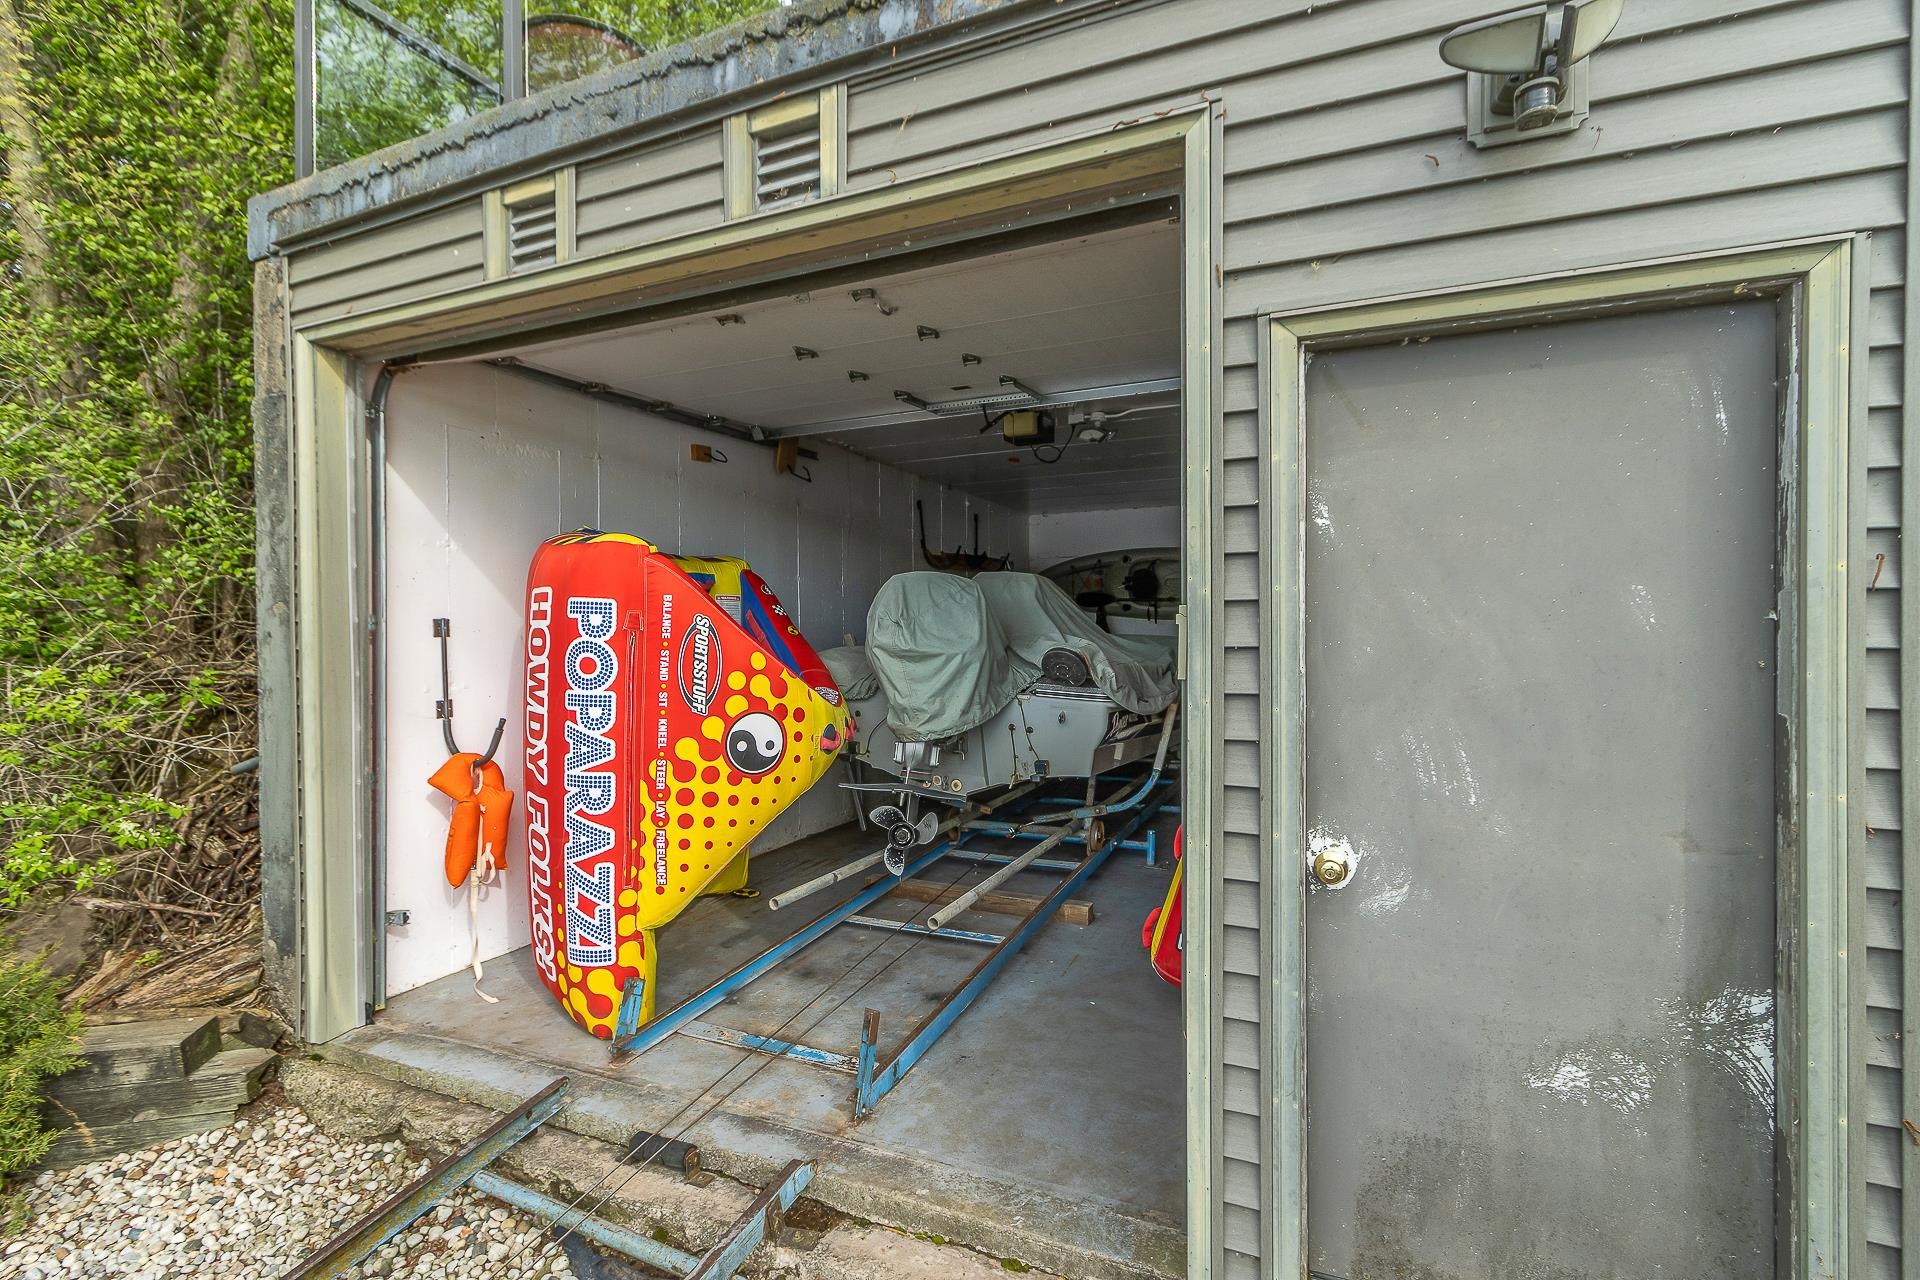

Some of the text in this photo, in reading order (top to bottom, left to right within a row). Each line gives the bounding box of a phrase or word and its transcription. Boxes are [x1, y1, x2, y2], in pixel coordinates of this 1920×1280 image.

[526, 586, 557, 982] HOWDY FOLKS!
[564, 596, 618, 966] POPARAZZI
[655, 594, 673, 886] BALANCE STAND SIT KNEEL STEER LAY FREELANCE
[692, 613, 711, 716] SPORTSSTUFF
